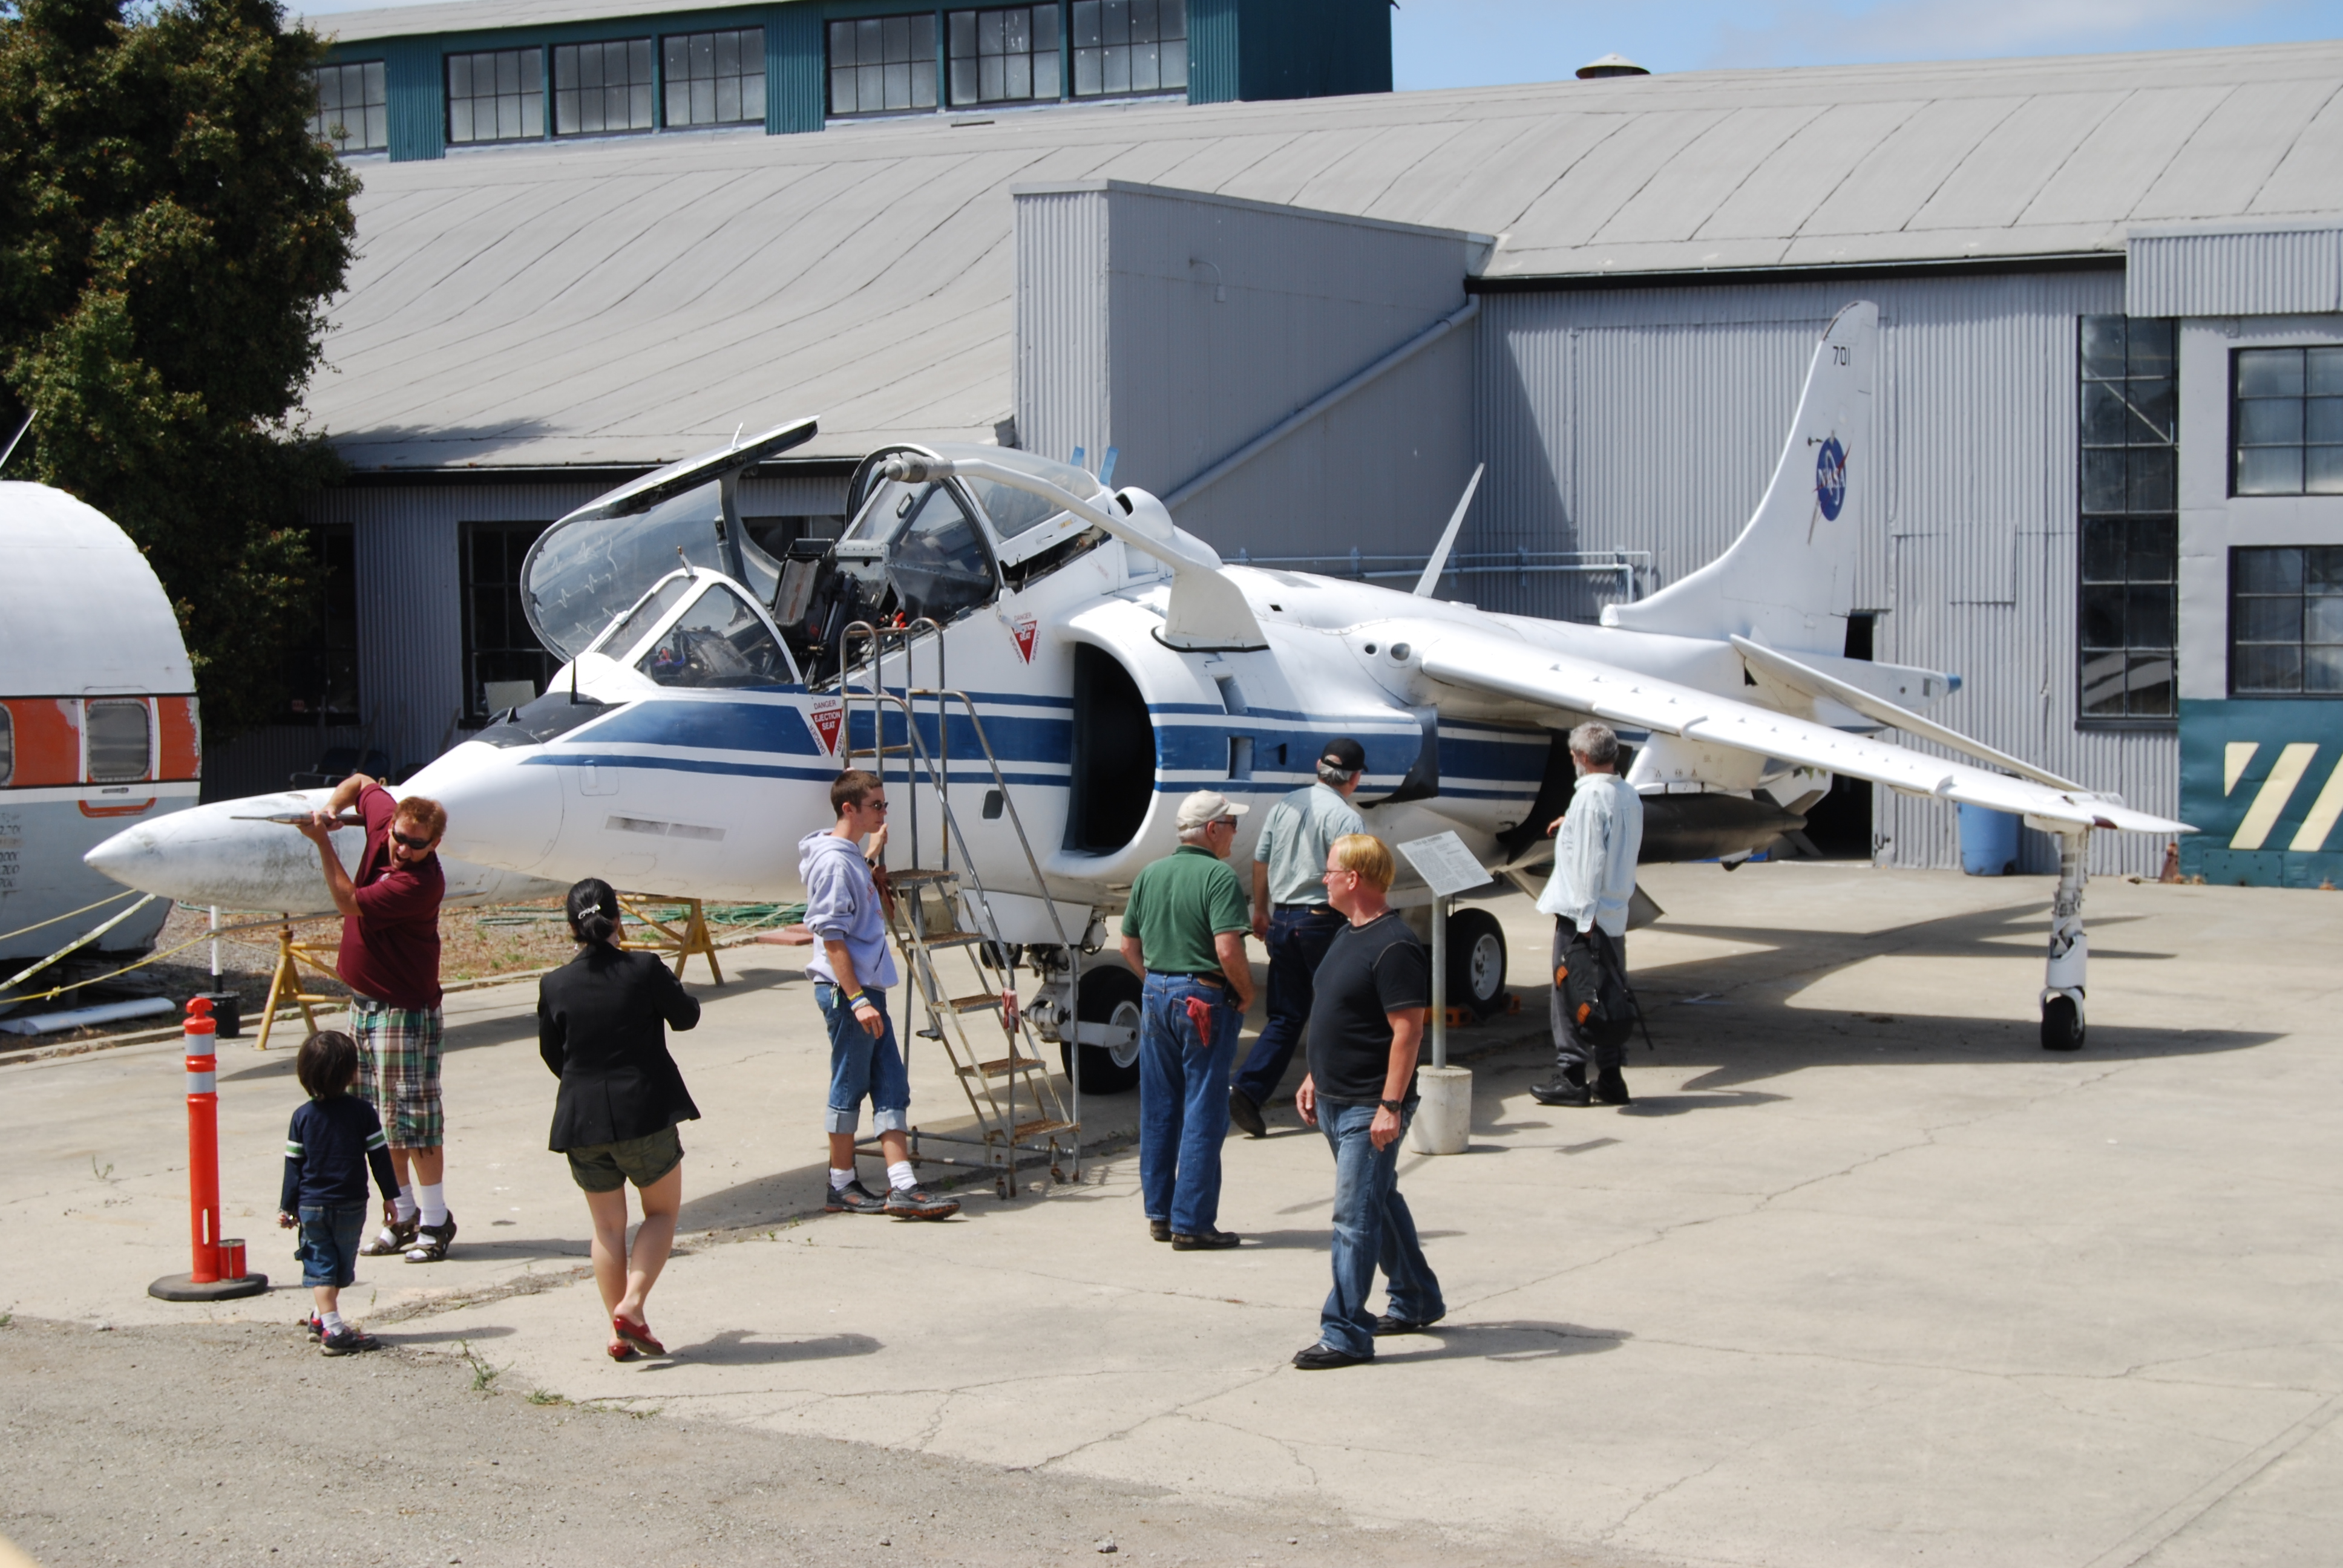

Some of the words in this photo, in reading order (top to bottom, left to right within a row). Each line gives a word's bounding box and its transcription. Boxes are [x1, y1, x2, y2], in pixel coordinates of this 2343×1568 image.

[1832, 345, 1850, 367] 701
[1817, 468, 1846, 488] NASA
[1014, 612, 1031, 621] DANGER
[1009, 636, 1023, 663] DANGER
[1032, 630, 1041, 661] DANGER
[814, 700, 836, 710] DANGER
[814, 711, 841, 722] EJECTION
[822, 721, 835, 730] SEAT
[809, 724, 826, 755] DANGER
